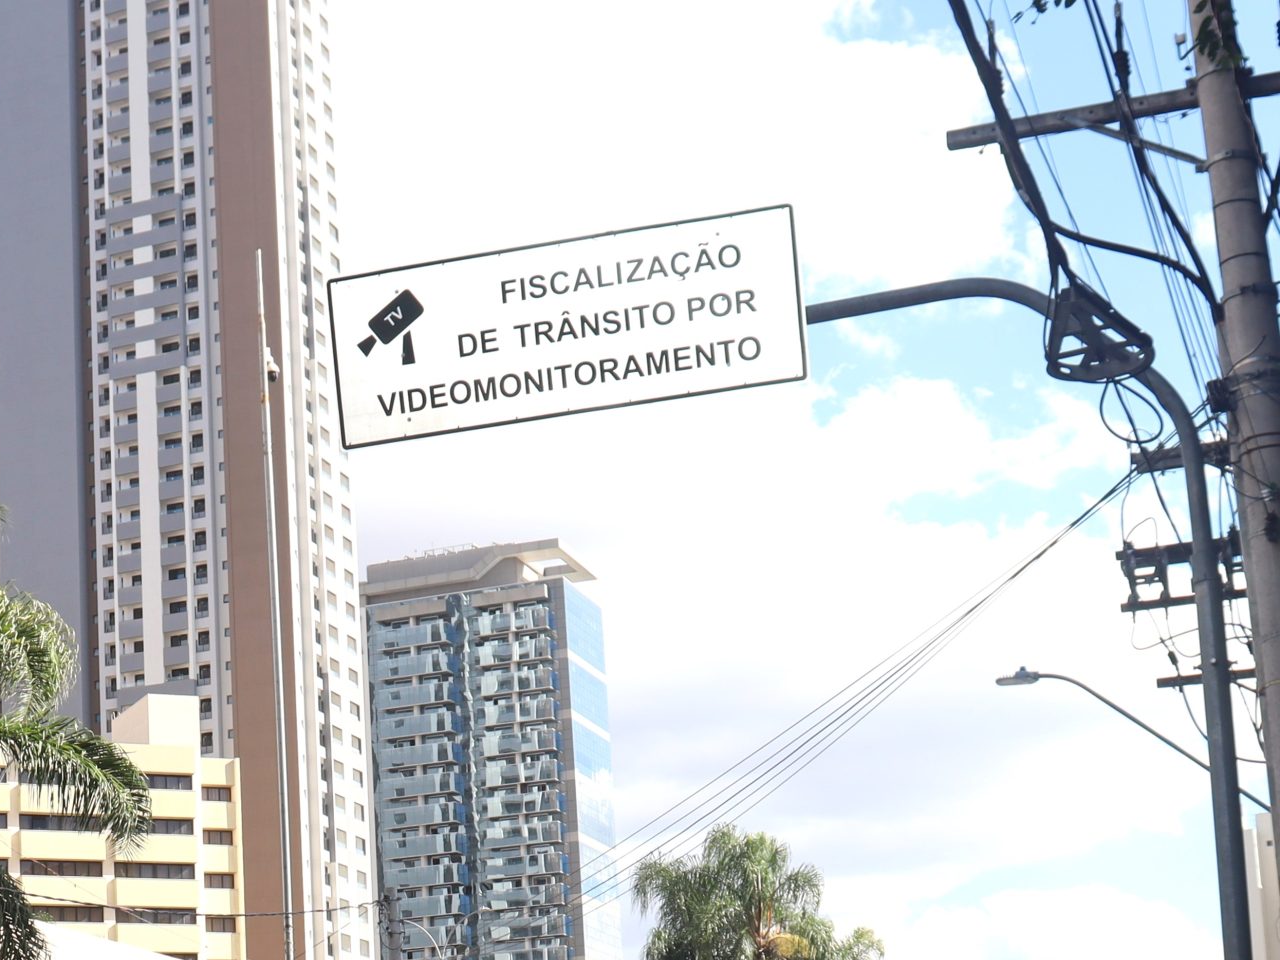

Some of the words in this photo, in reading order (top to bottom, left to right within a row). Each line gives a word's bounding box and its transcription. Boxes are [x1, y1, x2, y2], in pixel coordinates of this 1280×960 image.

[500, 242, 741, 304] FISCALIZAÇÃO
[384, 306, 403, 326] TV
[458, 329, 499, 358] DE
[513, 302, 675, 349] TRÂNSITO
[687, 289, 757, 322] POR
[377, 336, 762, 417] VIDEOMONITORAMENTO
